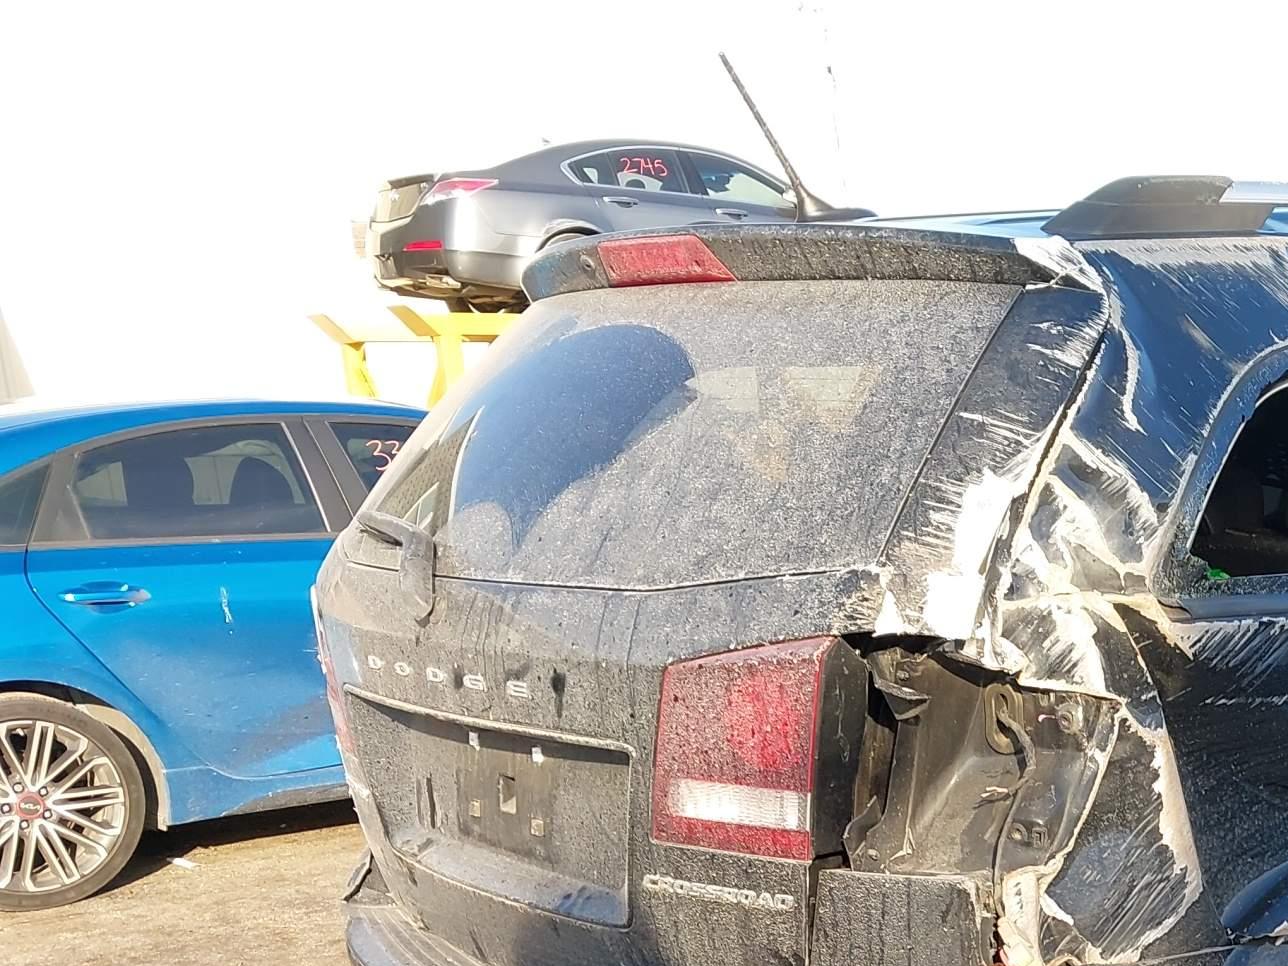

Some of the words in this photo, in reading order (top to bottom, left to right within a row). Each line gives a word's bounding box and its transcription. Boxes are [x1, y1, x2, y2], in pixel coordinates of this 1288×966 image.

[620, 157, 668, 177] 2745
[367, 654, 532, 699] DODGE
[642, 873, 795, 911] CROSSROAD
